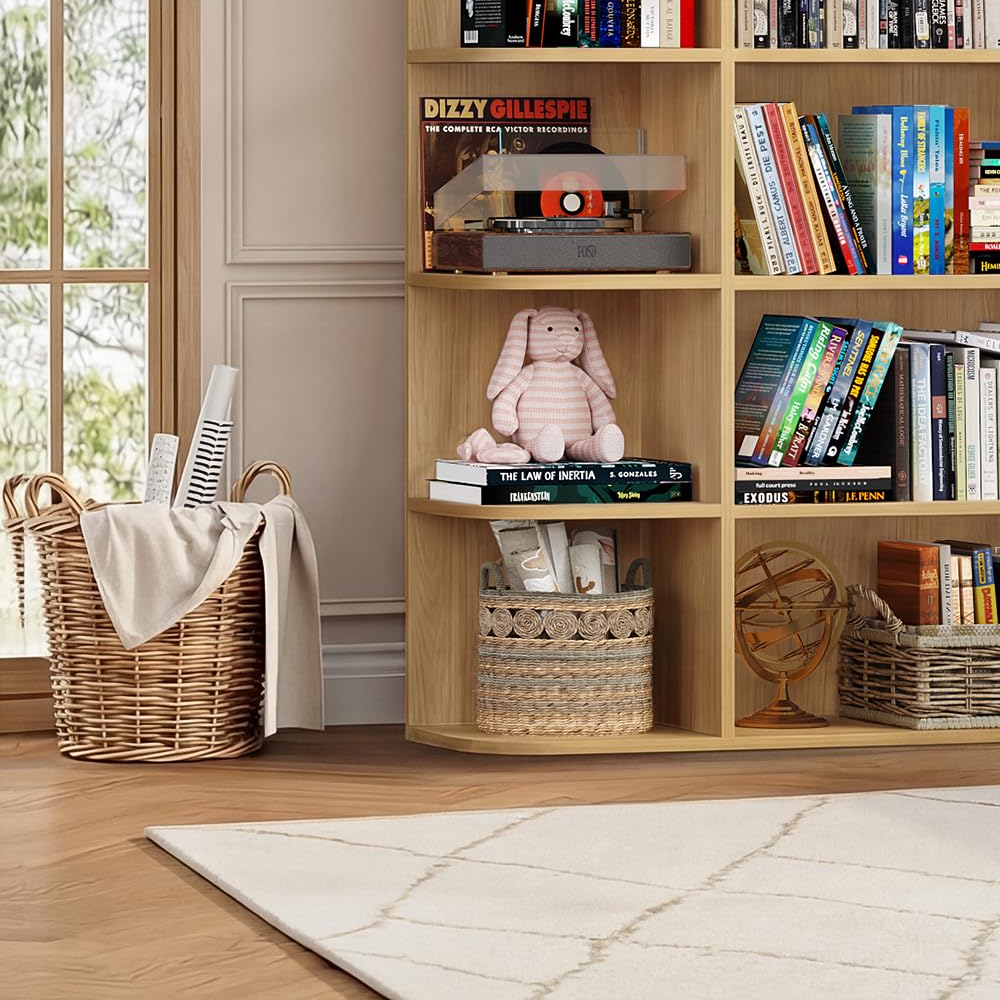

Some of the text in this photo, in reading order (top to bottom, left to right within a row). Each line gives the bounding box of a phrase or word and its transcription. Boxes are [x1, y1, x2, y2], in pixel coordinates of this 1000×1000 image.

[425, 99, 588, 119] DIZZY GILLESPIE
[442, 125, 483, 133] COMPLETE
[755, 124, 767, 153] PEST
[862, 334, 880, 362] SOMEONE
[811, 330, 865, 458] SENTINEL GARDNER
[917, 377, 928, 485] THE IDEA FACTORY
[501, 472, 518, 480] THE
[521, 472, 542, 480] LAW
[545, 472, 556, 480] OF
[558, 470, 596, 480] INERTIA
[744, 493, 788, 503] EXODUS
[859, 492, 885, 500] PENN
